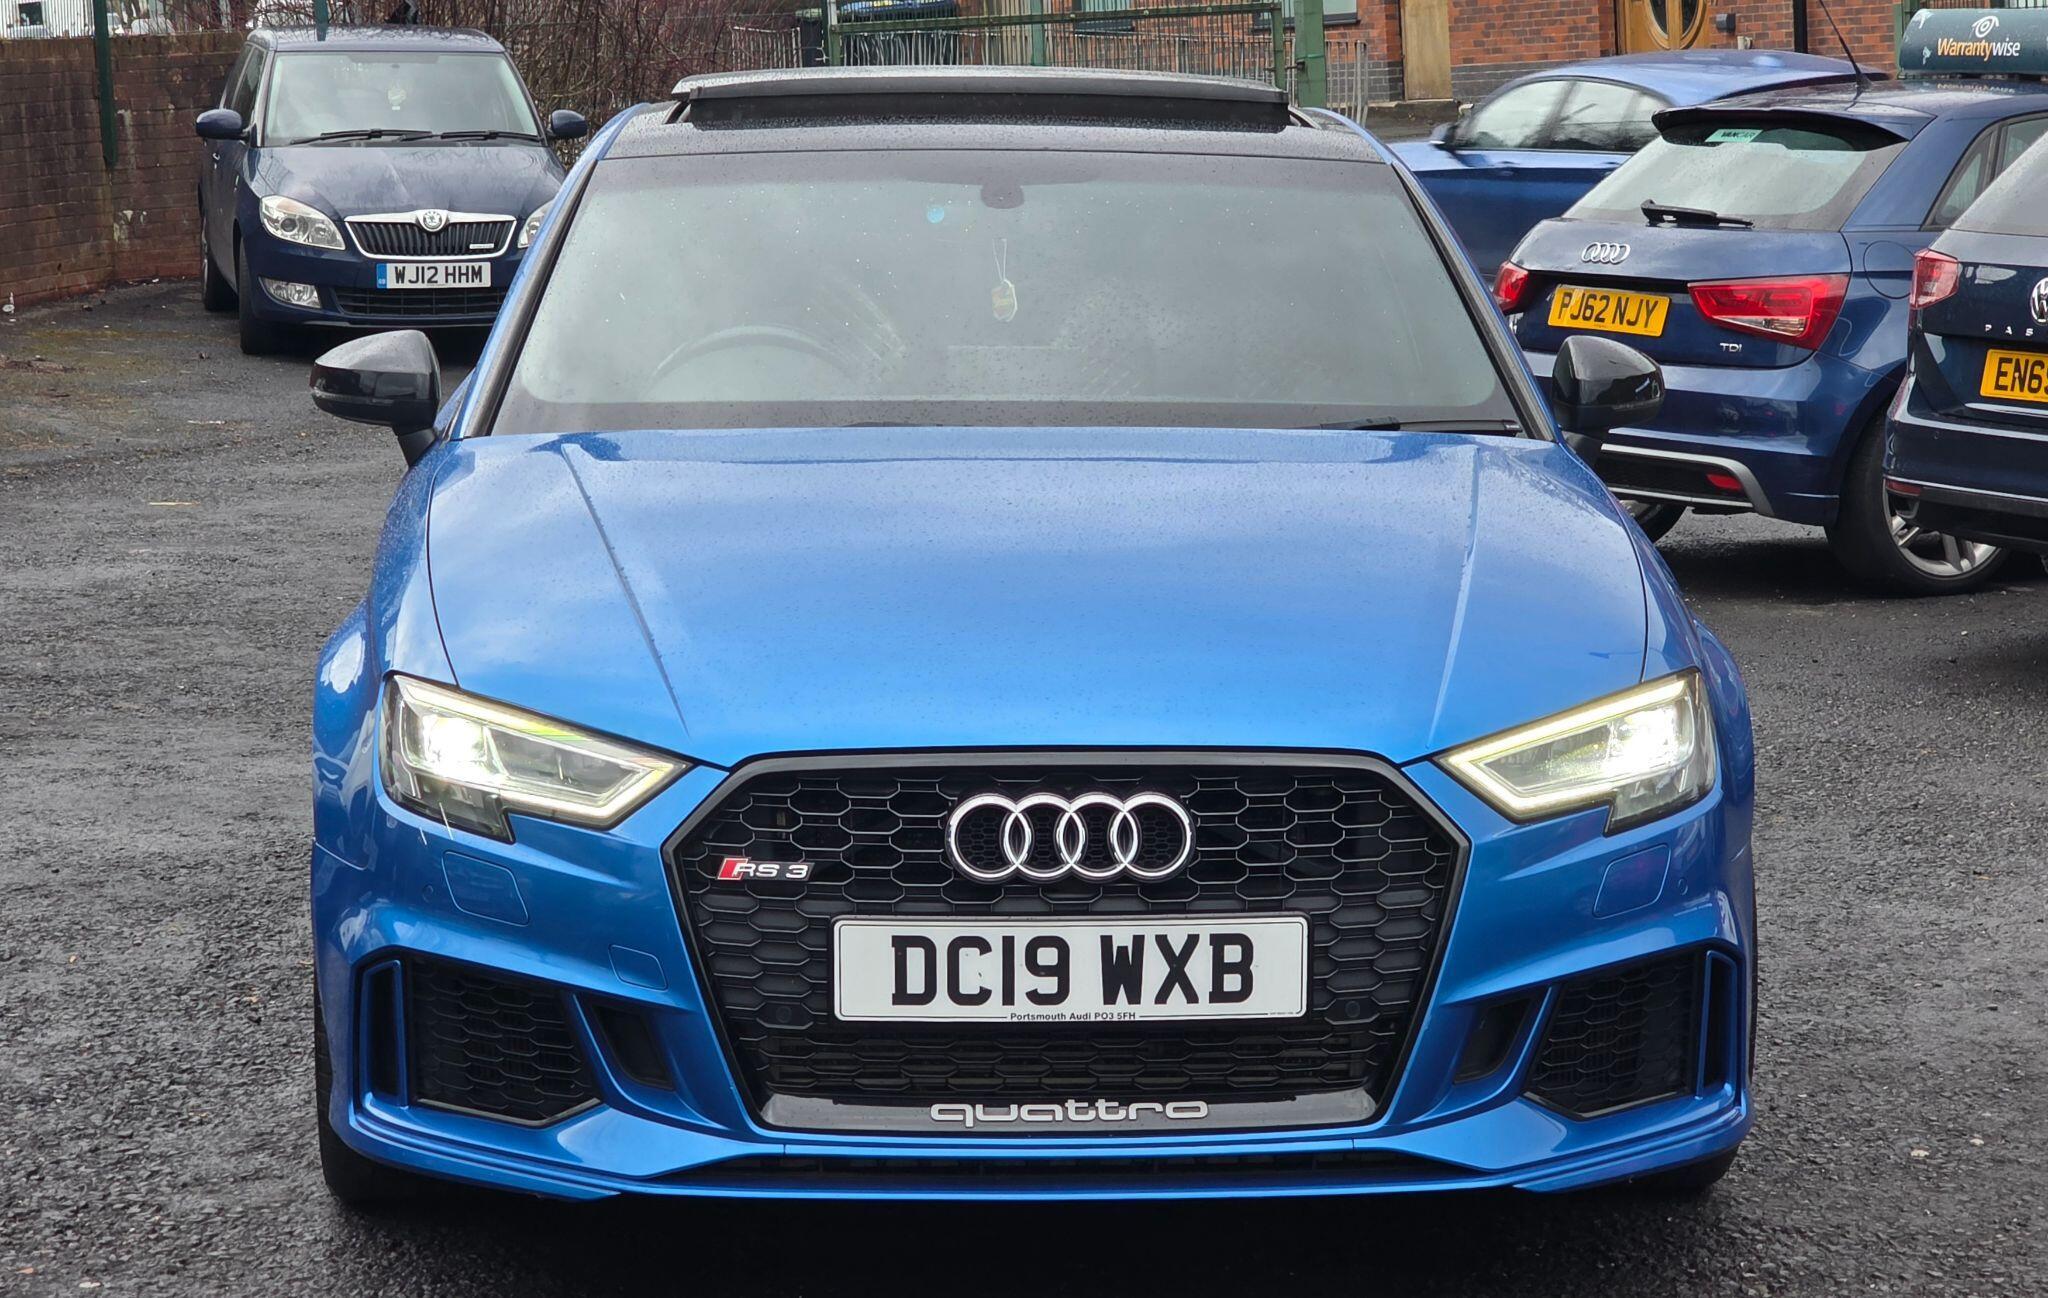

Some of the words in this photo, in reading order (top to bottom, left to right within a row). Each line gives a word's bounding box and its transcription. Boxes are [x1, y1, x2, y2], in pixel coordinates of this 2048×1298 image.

[1937, 38, 2020, 61] Warrantywise
[395, 266, 438, 284] WJ12
[444, 265, 482, 283] HHM
[1558, 291, 1610, 323] PJ62
[1611, 296, 1658, 329] NJY
[1719, 342, 1742, 352] TDI
[1994, 357, 2048, 395] EN6
[732, 863, 780, 877] RS
[785, 864, 808, 878] 3
[891, 935, 1070, 1006] DC19
[1099, 933, 1254, 1005] WXB
[1010, 1012, 1066, 1020] Portsmouth
[1069, 1012, 1091, 1020] Audi
[1094, 1012, 1114, 1020] PO3
[1117, 1012, 1136, 1020] 5FH
[930, 1099, 1208, 1127] quattro
